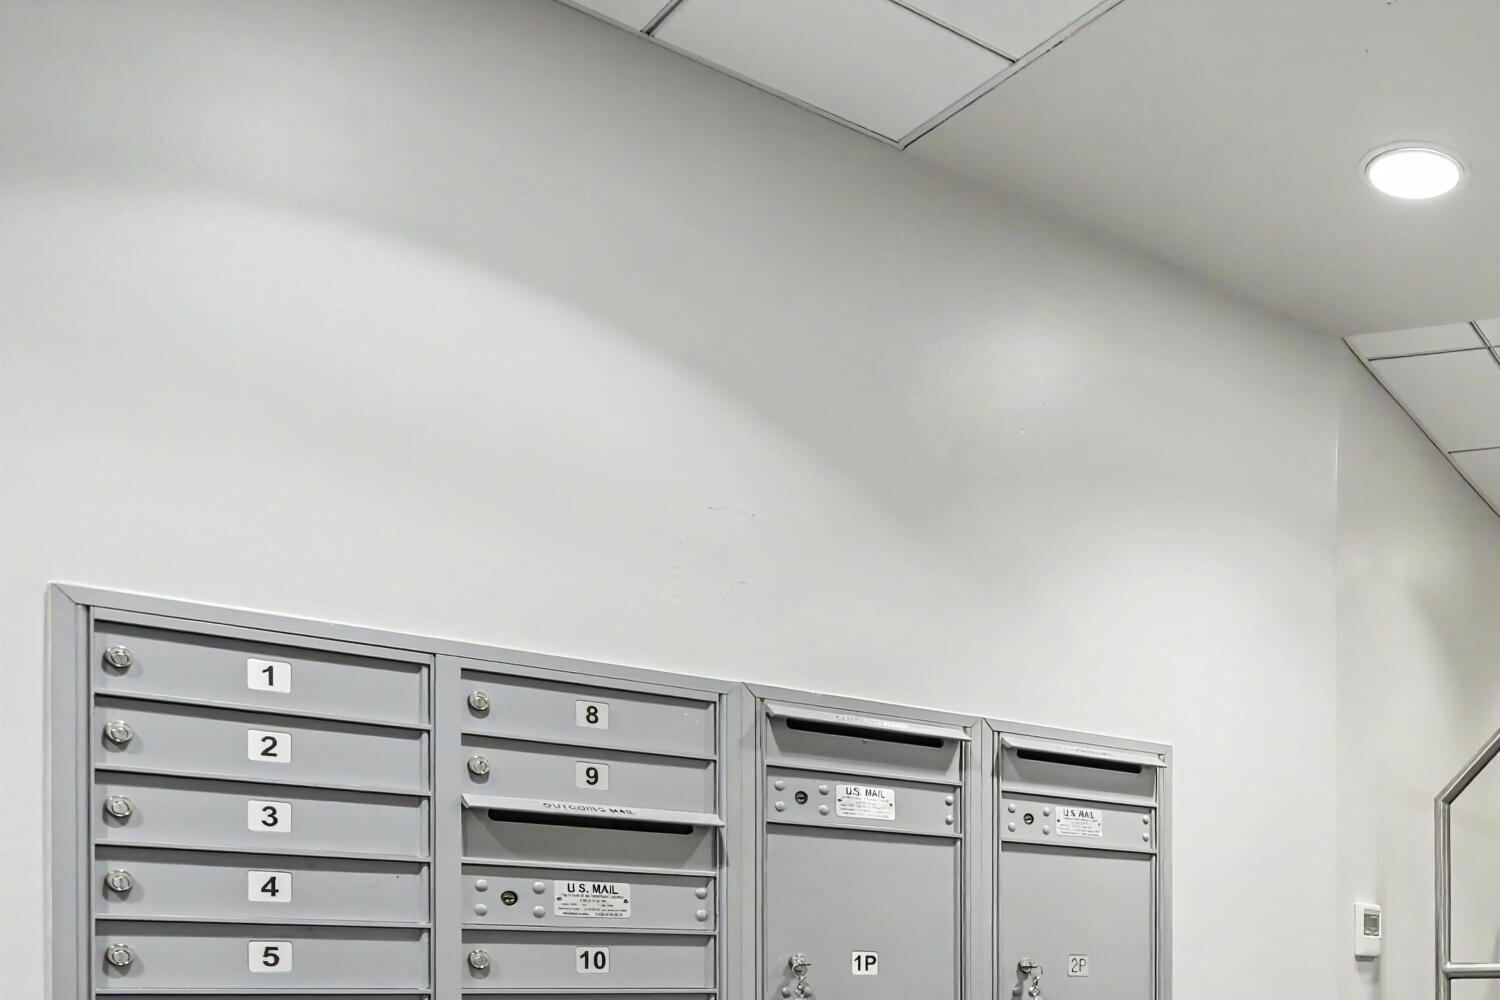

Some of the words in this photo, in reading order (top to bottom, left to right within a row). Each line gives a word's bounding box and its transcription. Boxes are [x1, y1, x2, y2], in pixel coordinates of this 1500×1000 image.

[262, 665, 274, 686] 1
[585, 705, 599, 724] 8
[260, 736, 278, 757] 2
[585, 766, 599, 786] 9
[865, 788, 886, 799] MAIL
[261, 805, 279, 827] 3
[1078, 810, 1095, 819] MAL
[260, 876, 279, 897] 4
[592, 884, 619, 895] MAIL
[262, 946, 280, 967] 5
[579, 950, 606, 970] 10
[854, 954, 877, 971] 1P
[1071, 957, 1087, 973] 2P
